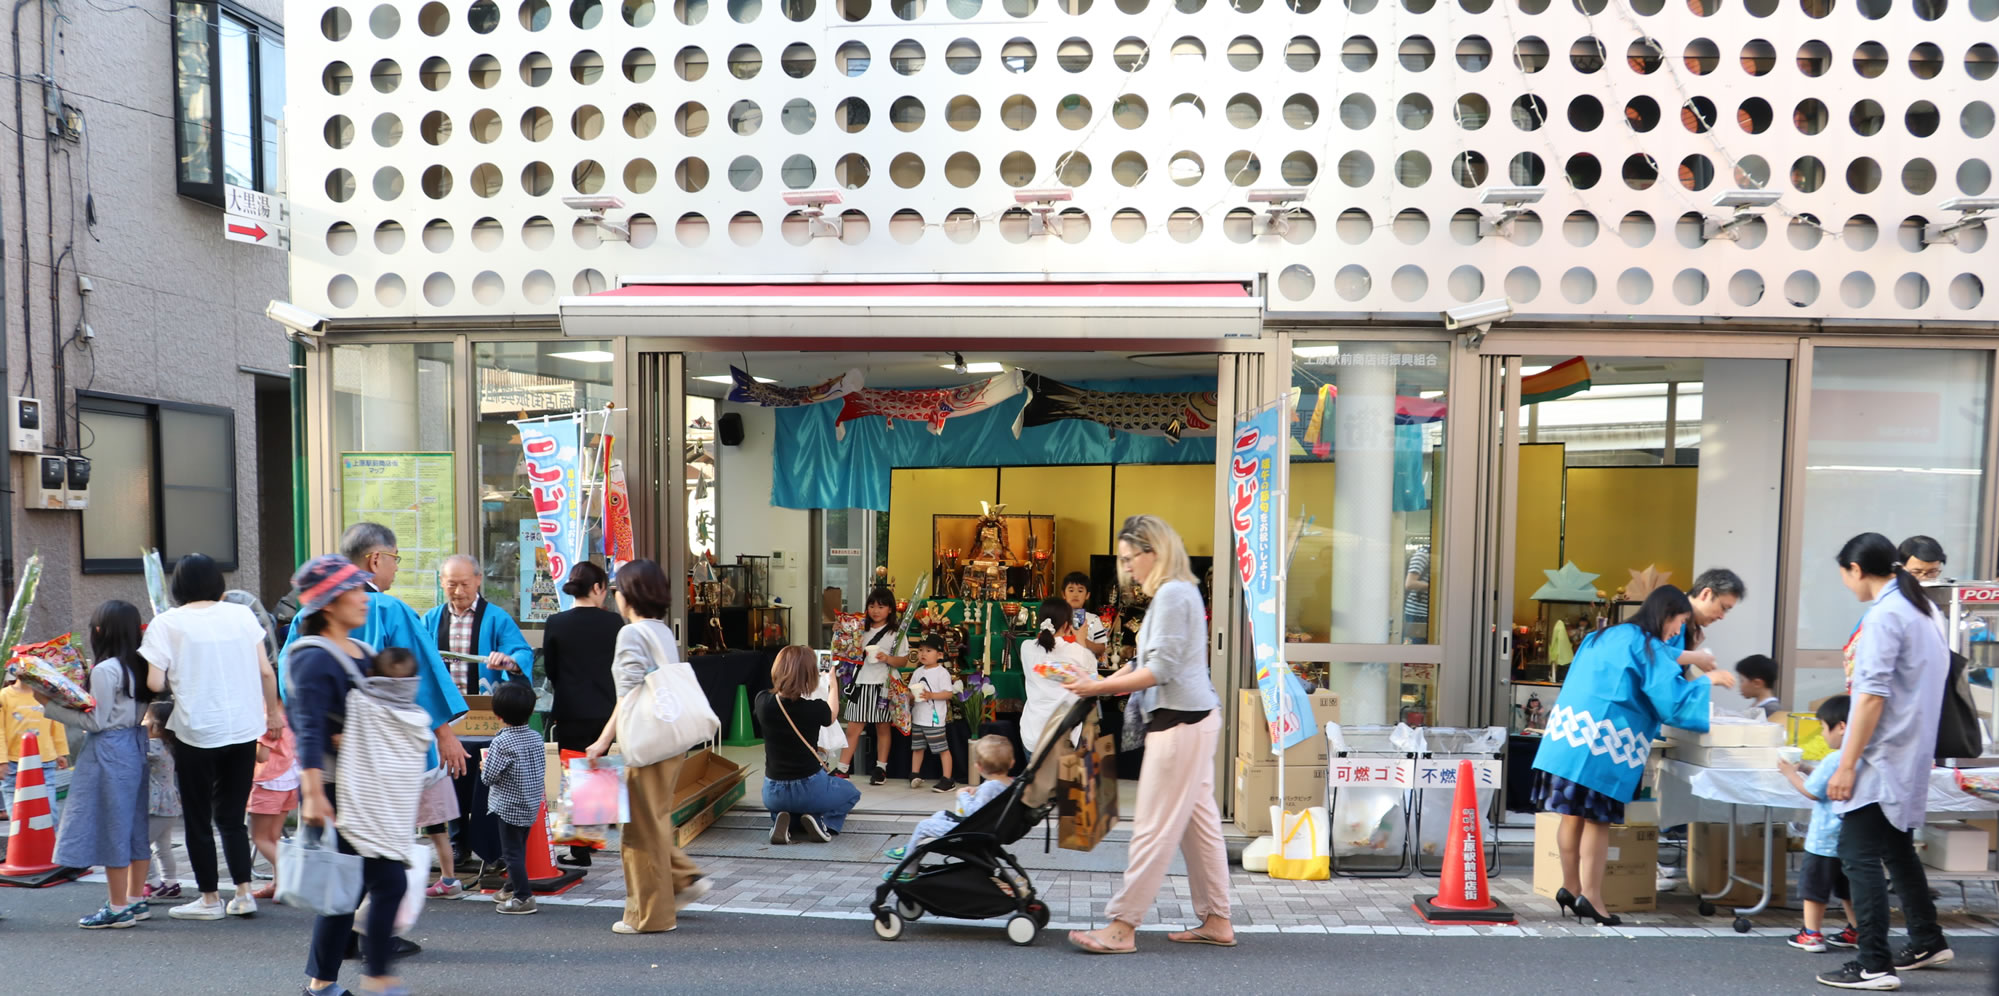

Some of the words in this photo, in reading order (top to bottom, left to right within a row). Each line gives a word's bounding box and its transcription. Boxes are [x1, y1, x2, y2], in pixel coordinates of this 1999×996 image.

[227, 188, 271, 218] 大黒湯
[1303, 353, 1439, 367] 上原駅前商店街振興組合
[465, 721, 500, 731] しょうぶ
[1336, 766, 1406, 783] 可燃ゴミ
[1421, 767, 1493, 784] 不燃ミ
[1463, 832, 1478, 901] 上原駅前商店街
